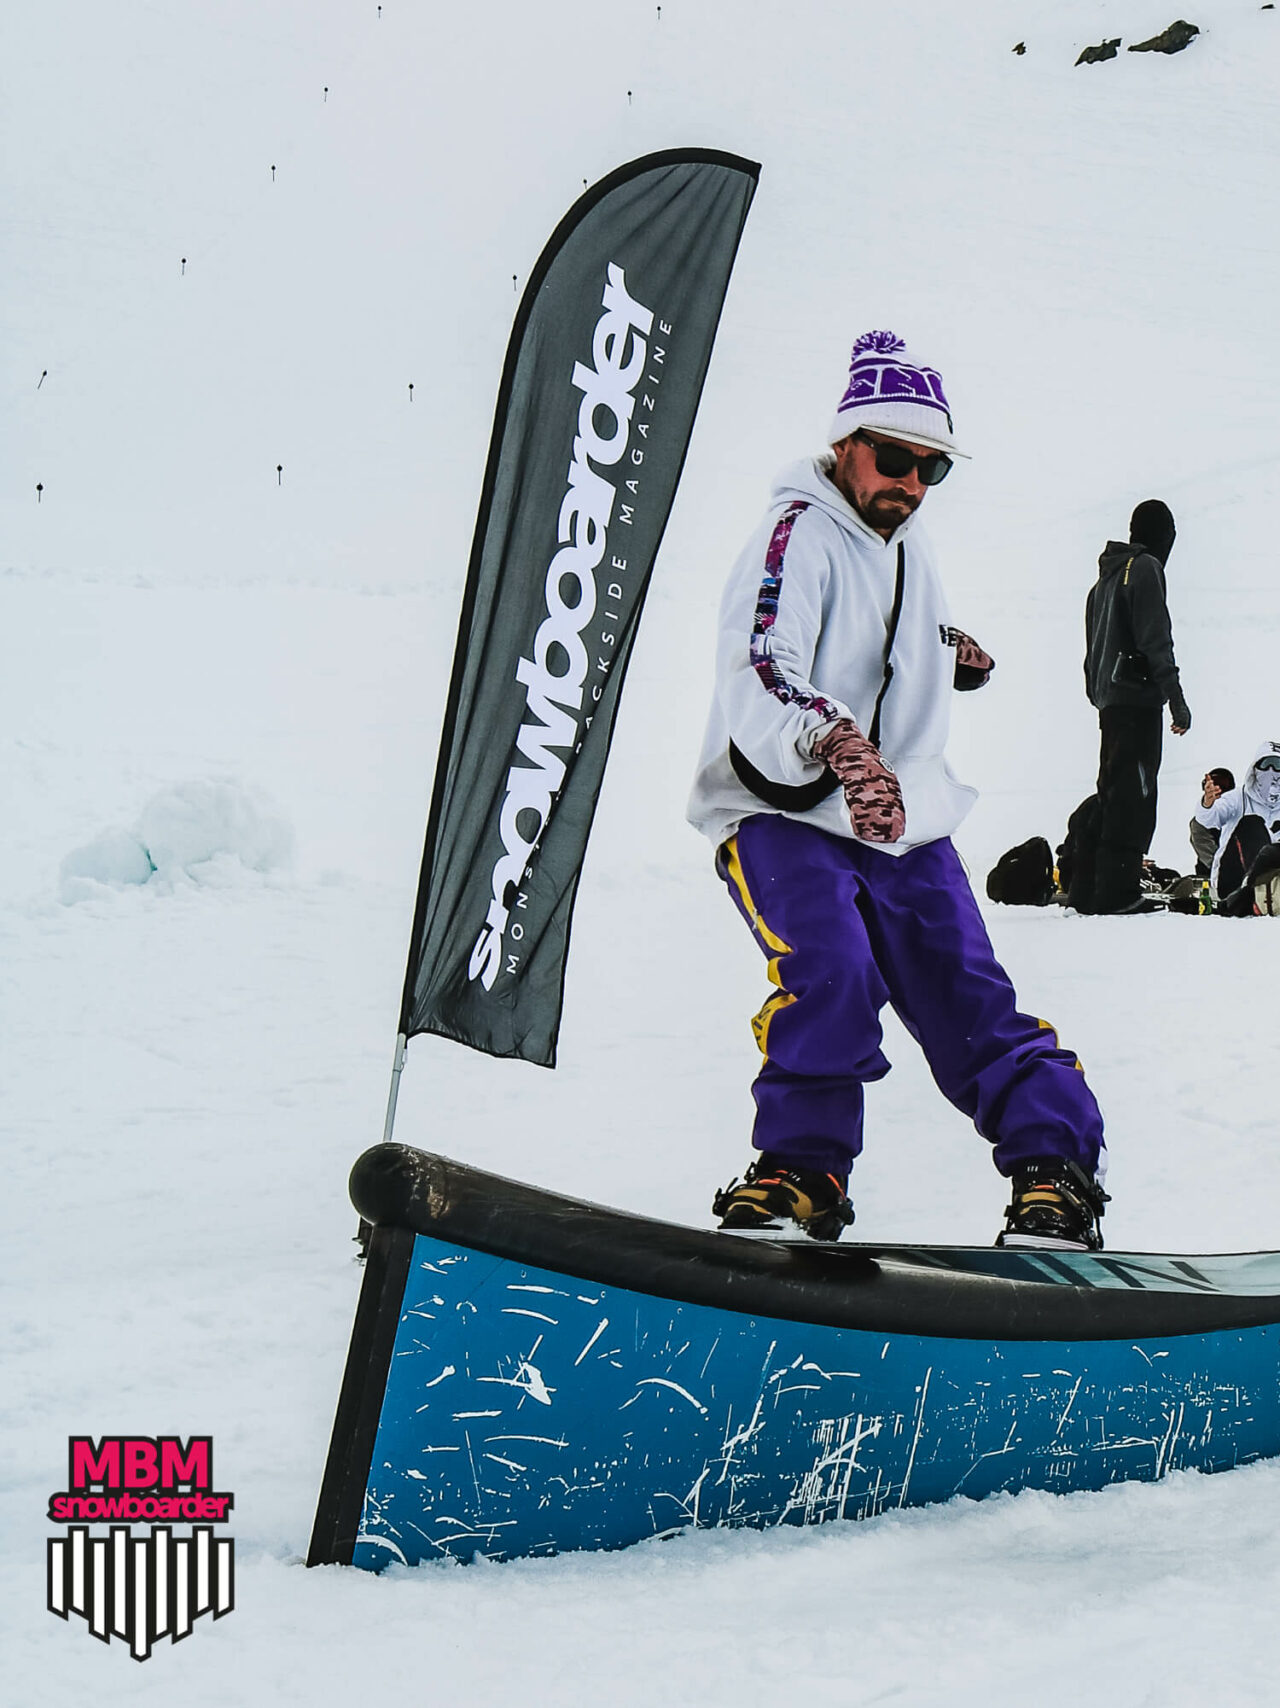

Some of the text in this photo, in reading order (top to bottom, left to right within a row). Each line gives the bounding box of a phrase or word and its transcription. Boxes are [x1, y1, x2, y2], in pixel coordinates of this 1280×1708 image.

[467, 261, 655, 992] snowboarder
[507, 320, 672, 974] MONS ACKSIDE MAGAZINE
